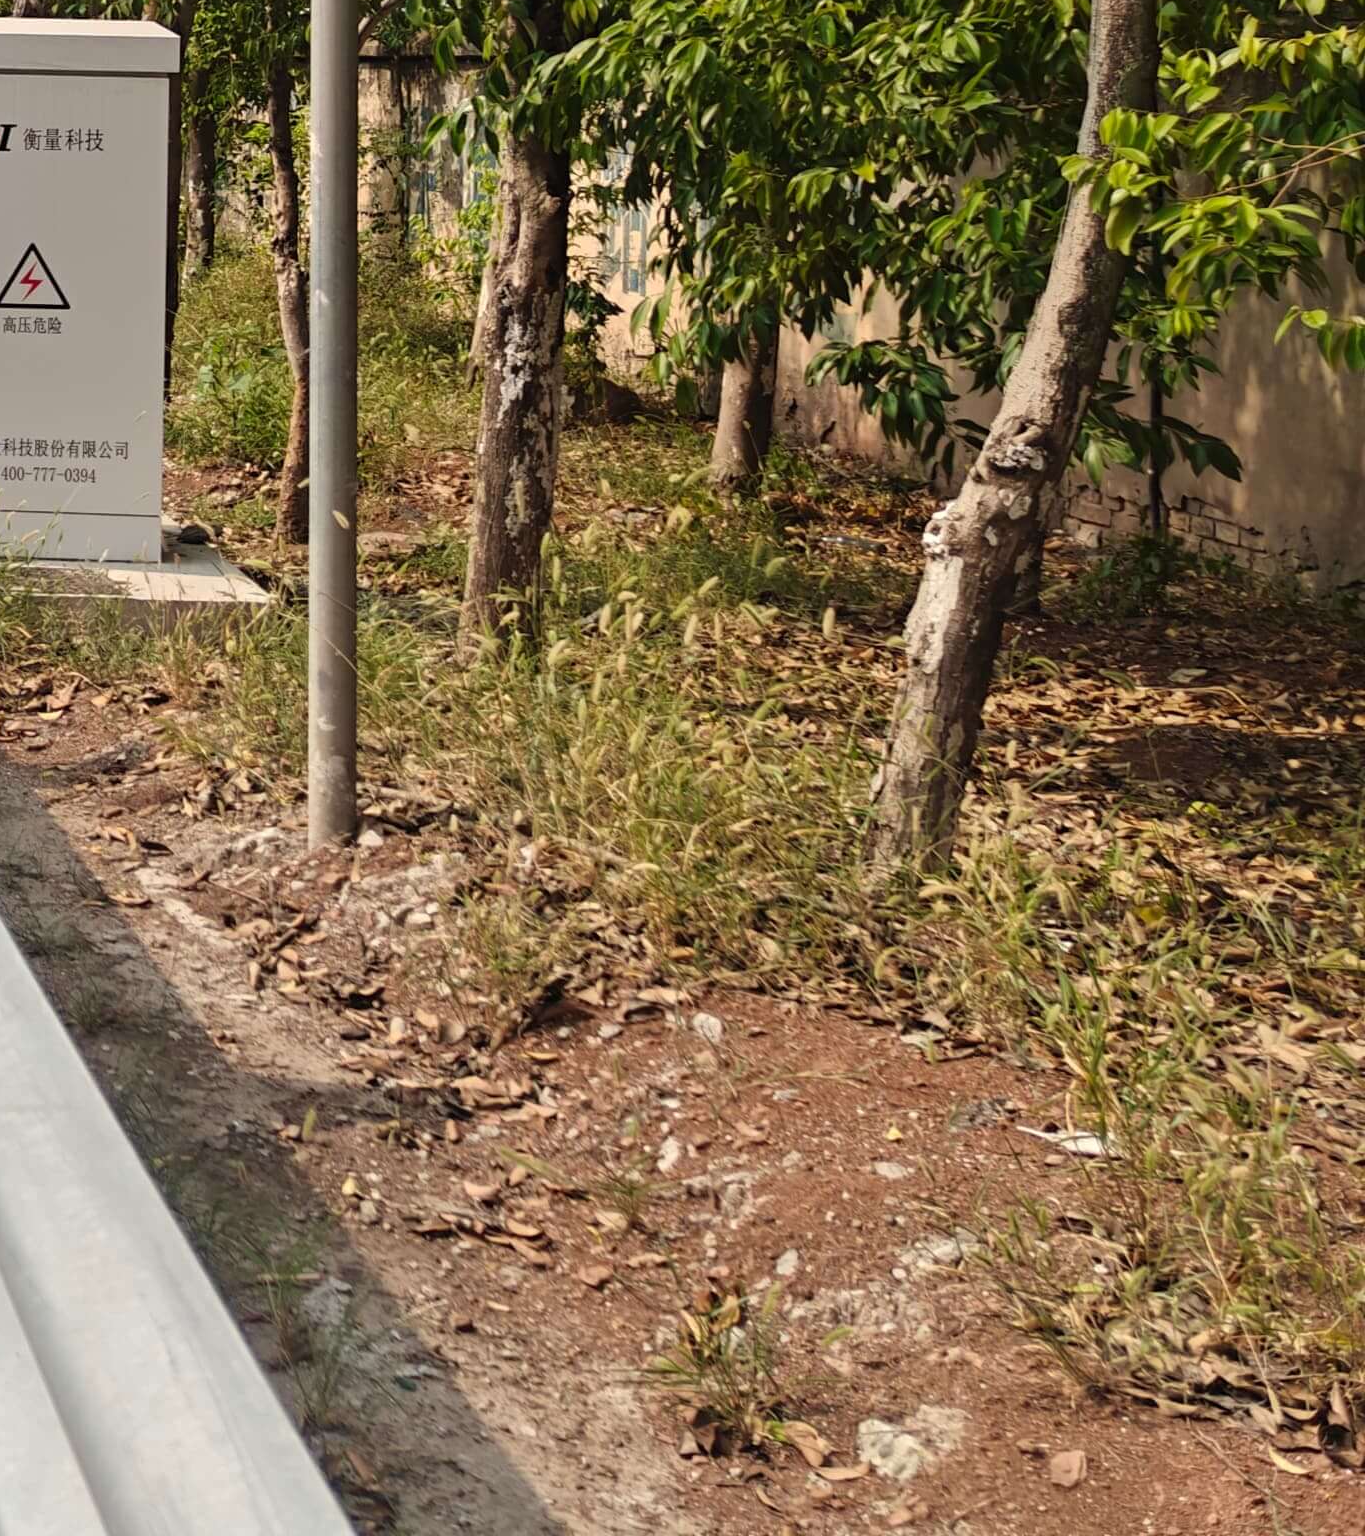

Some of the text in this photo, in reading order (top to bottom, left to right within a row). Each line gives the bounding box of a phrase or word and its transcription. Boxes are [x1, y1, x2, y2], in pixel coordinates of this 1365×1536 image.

[22, 128, 104, 152] 衡量科技
[2, 315, 62, 334] 高压危险
